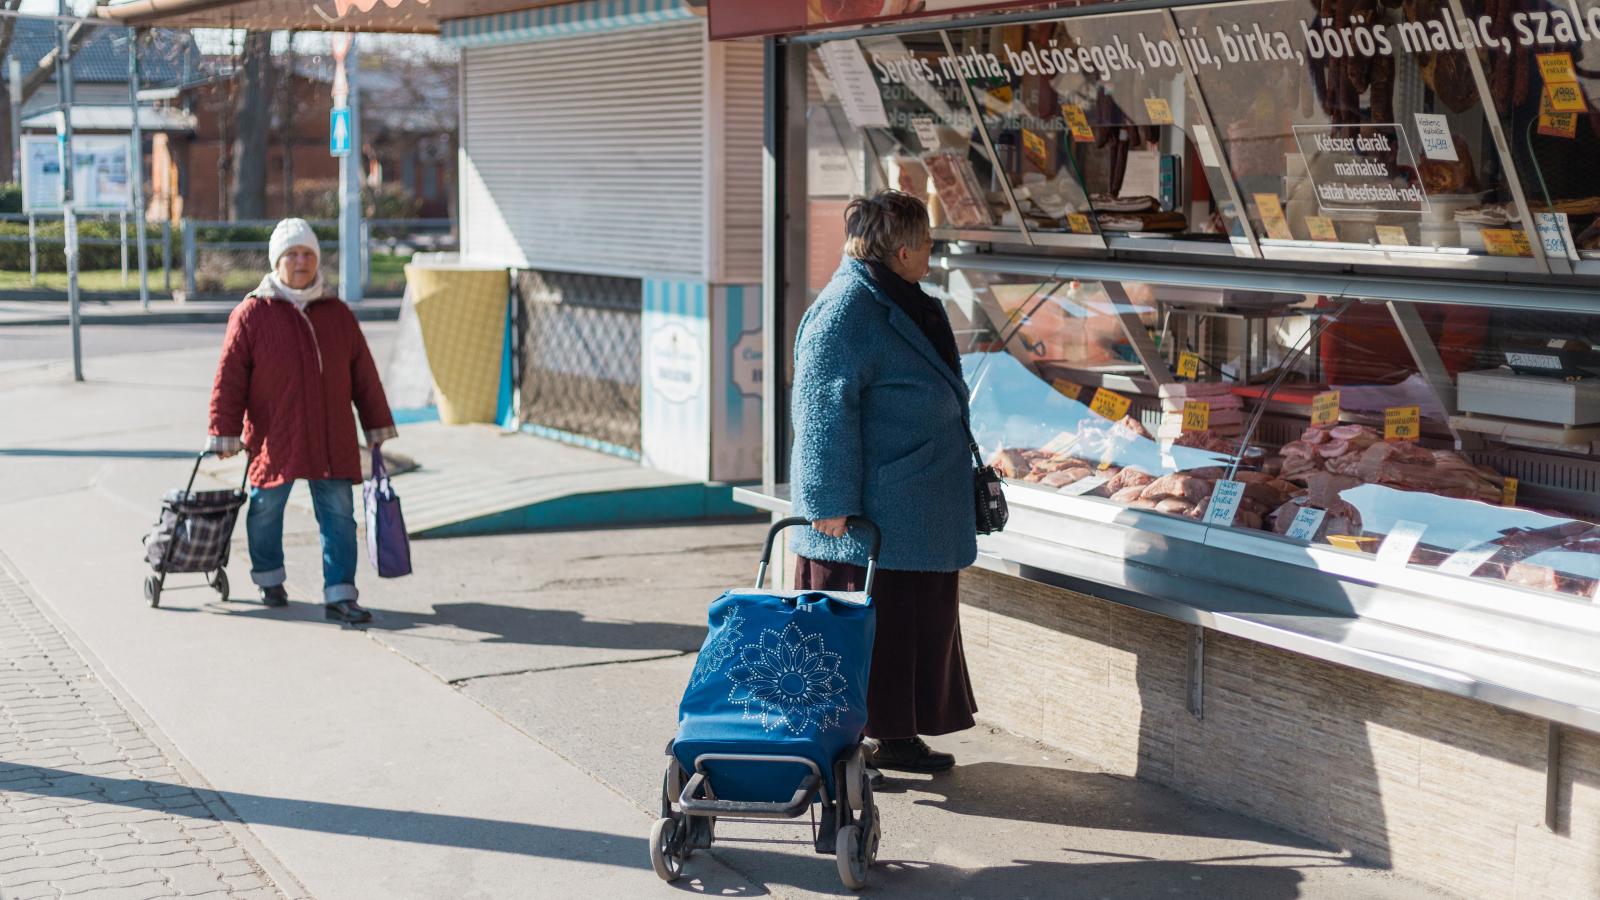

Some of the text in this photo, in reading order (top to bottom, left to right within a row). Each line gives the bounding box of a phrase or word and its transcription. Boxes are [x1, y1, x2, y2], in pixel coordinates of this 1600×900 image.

[872, 49, 943, 86] Sertés,
[938, 45, 1012, 83] marha,
[1003, 34, 1146, 82] belsőségek,
[1137, 27, 1222, 75] borjú,
[1216, 23, 1304, 67] birka,
[1300, 15, 1393, 59] bőrös
[1397, 7, 1512, 55] malac,
[1314, 133, 1391, 151] Kétszer darált
[1334, 158, 1388, 176] marhahús
[1318, 183, 1424, 201] tatár beefsteak-nek
